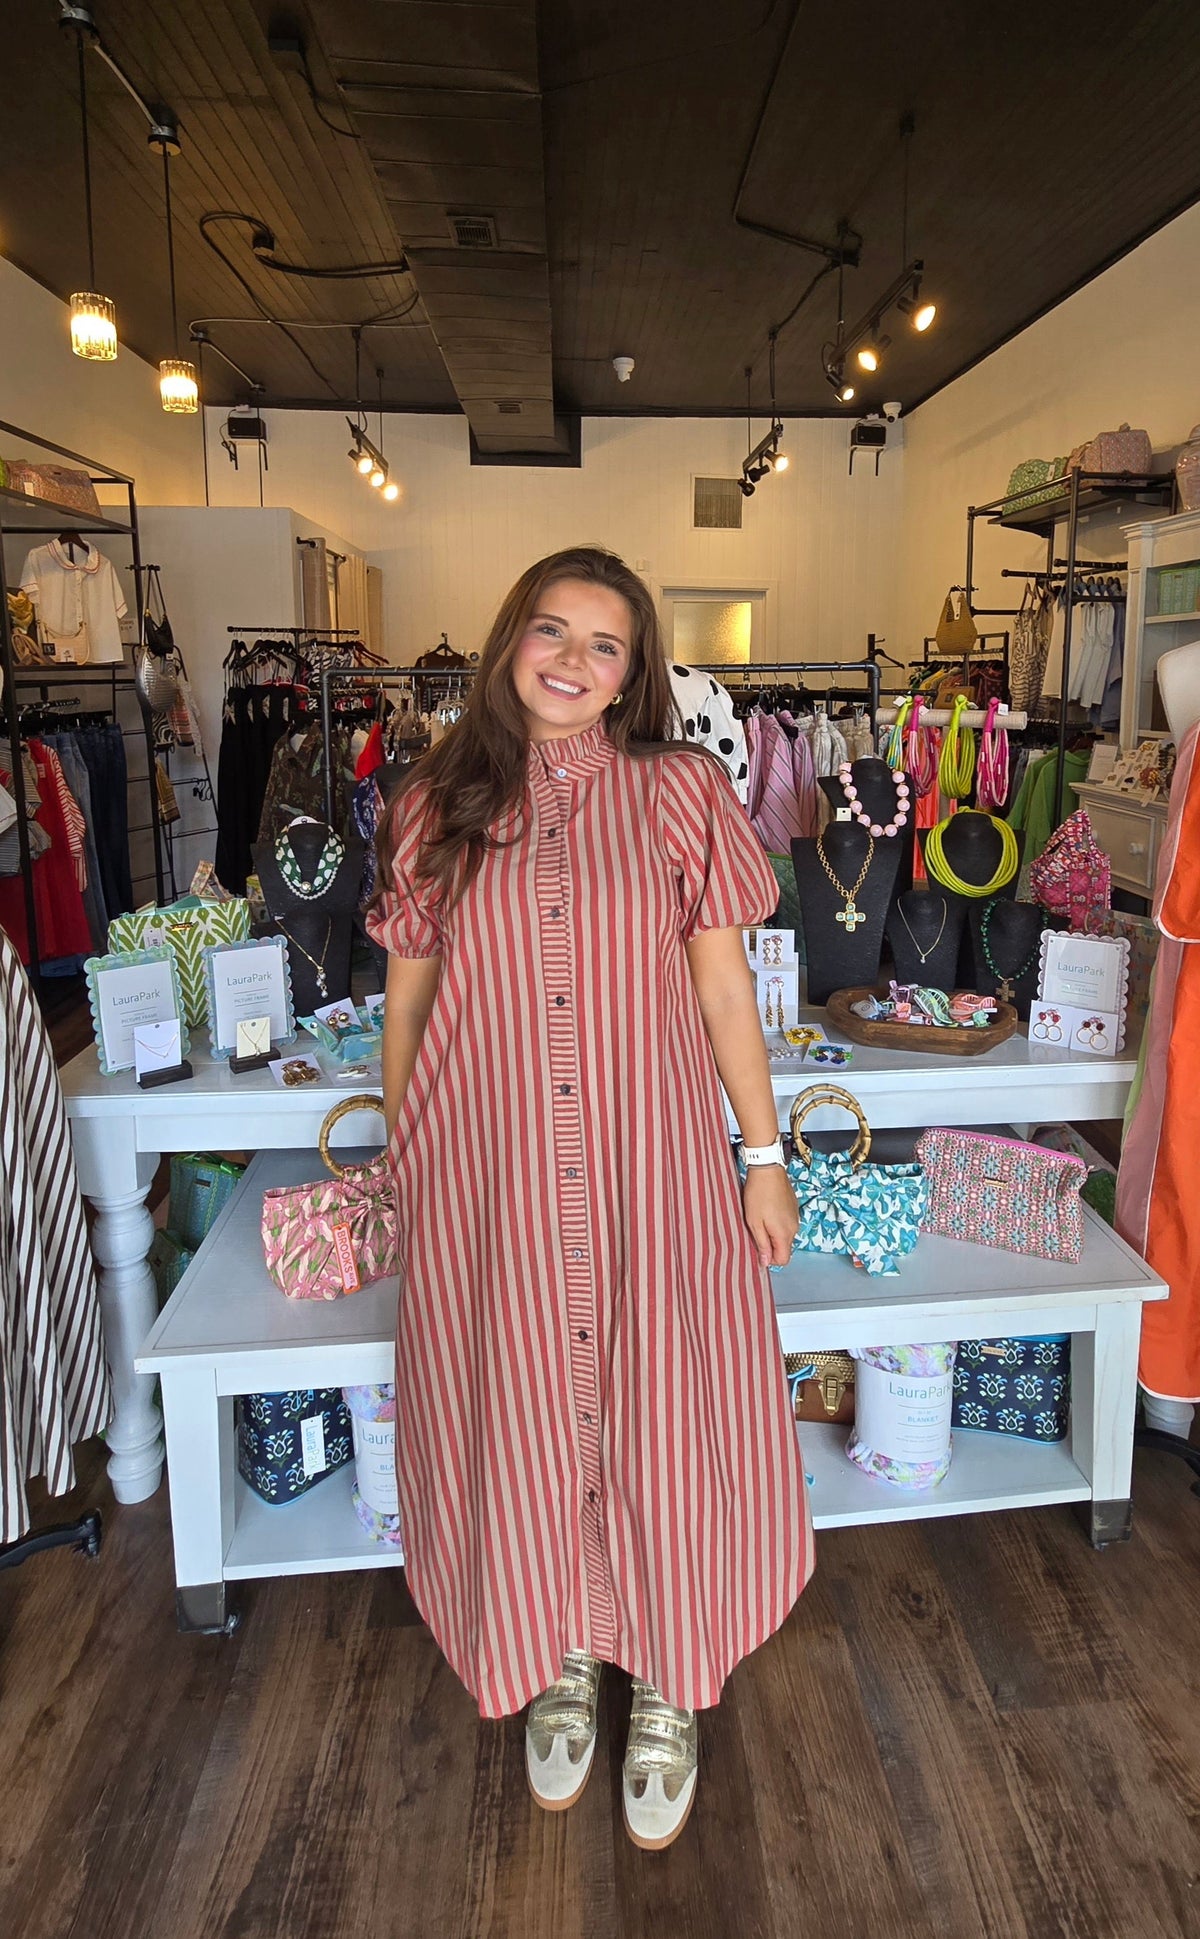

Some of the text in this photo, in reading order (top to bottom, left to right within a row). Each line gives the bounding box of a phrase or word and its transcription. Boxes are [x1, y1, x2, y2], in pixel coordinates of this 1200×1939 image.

[227, 971, 272, 986] LauraPark
[1057, 962, 1105, 977] LauraPark
[112, 989, 160, 1006] LauraPark
[337, 1230, 353, 1273] BROOKS
[362, 1426, 396, 1445] Laura
[306, 1425, 320, 1468] LauraPark
